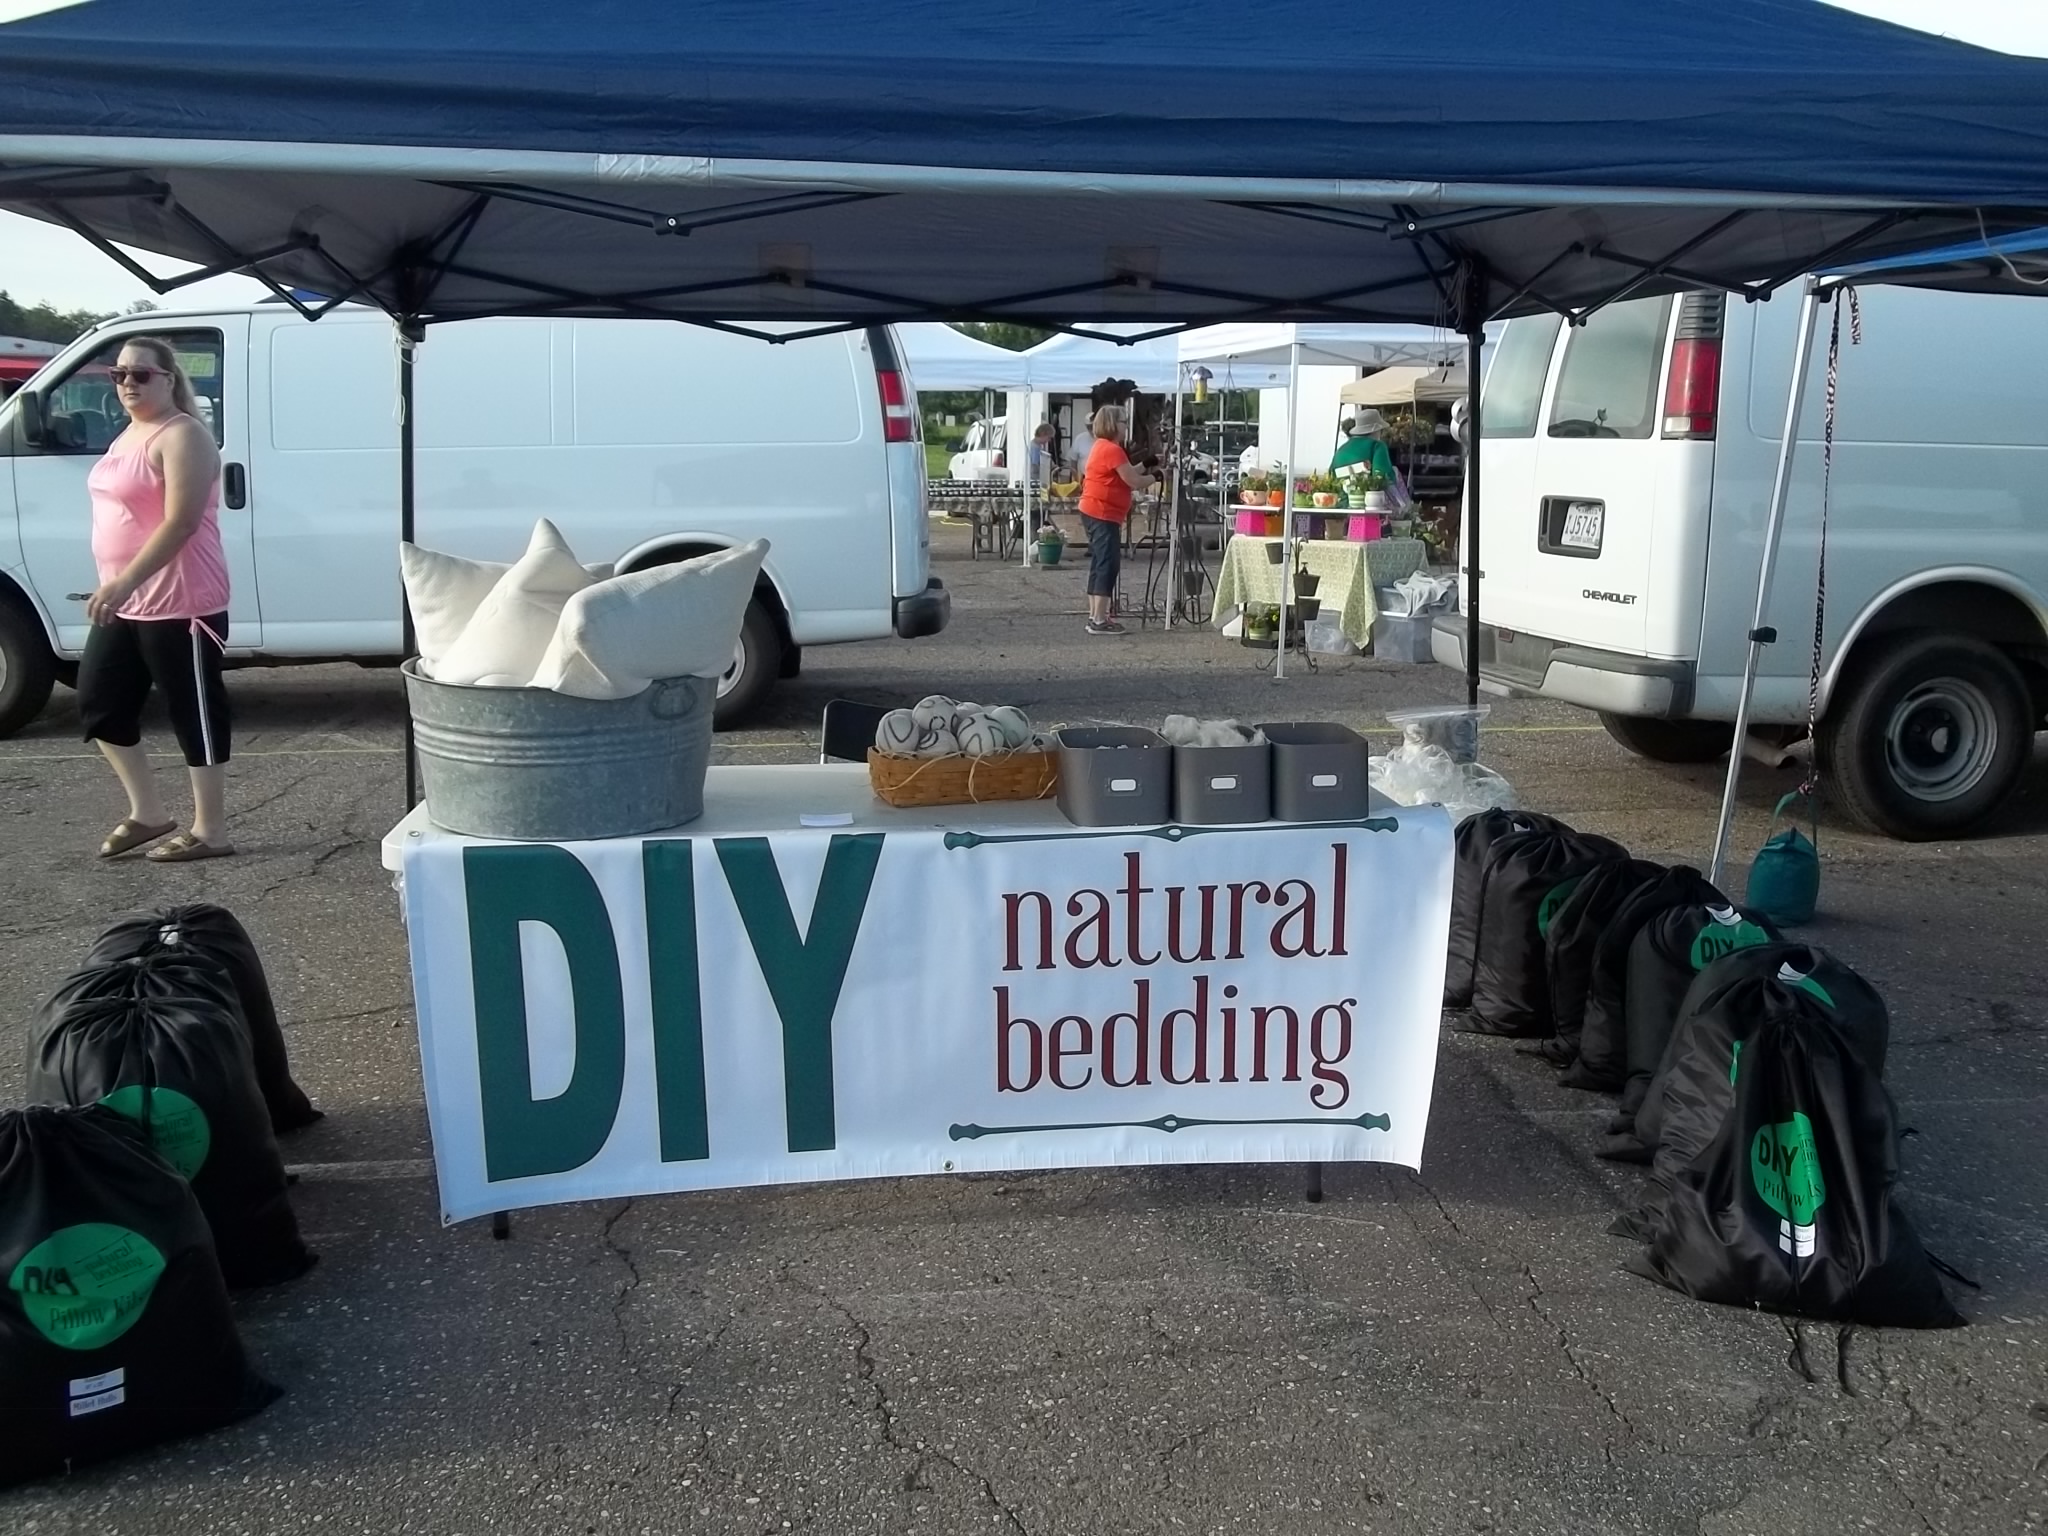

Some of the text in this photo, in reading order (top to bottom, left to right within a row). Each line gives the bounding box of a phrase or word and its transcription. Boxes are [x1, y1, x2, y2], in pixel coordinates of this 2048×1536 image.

[1582, 588, 1638, 605] CHEVROLET
[1001, 843, 1349, 970] natural
[463, 832, 885, 1182] DIY
[994, 975, 1358, 1110] bedding
[50, 1306, 105, 1331] Pillow
